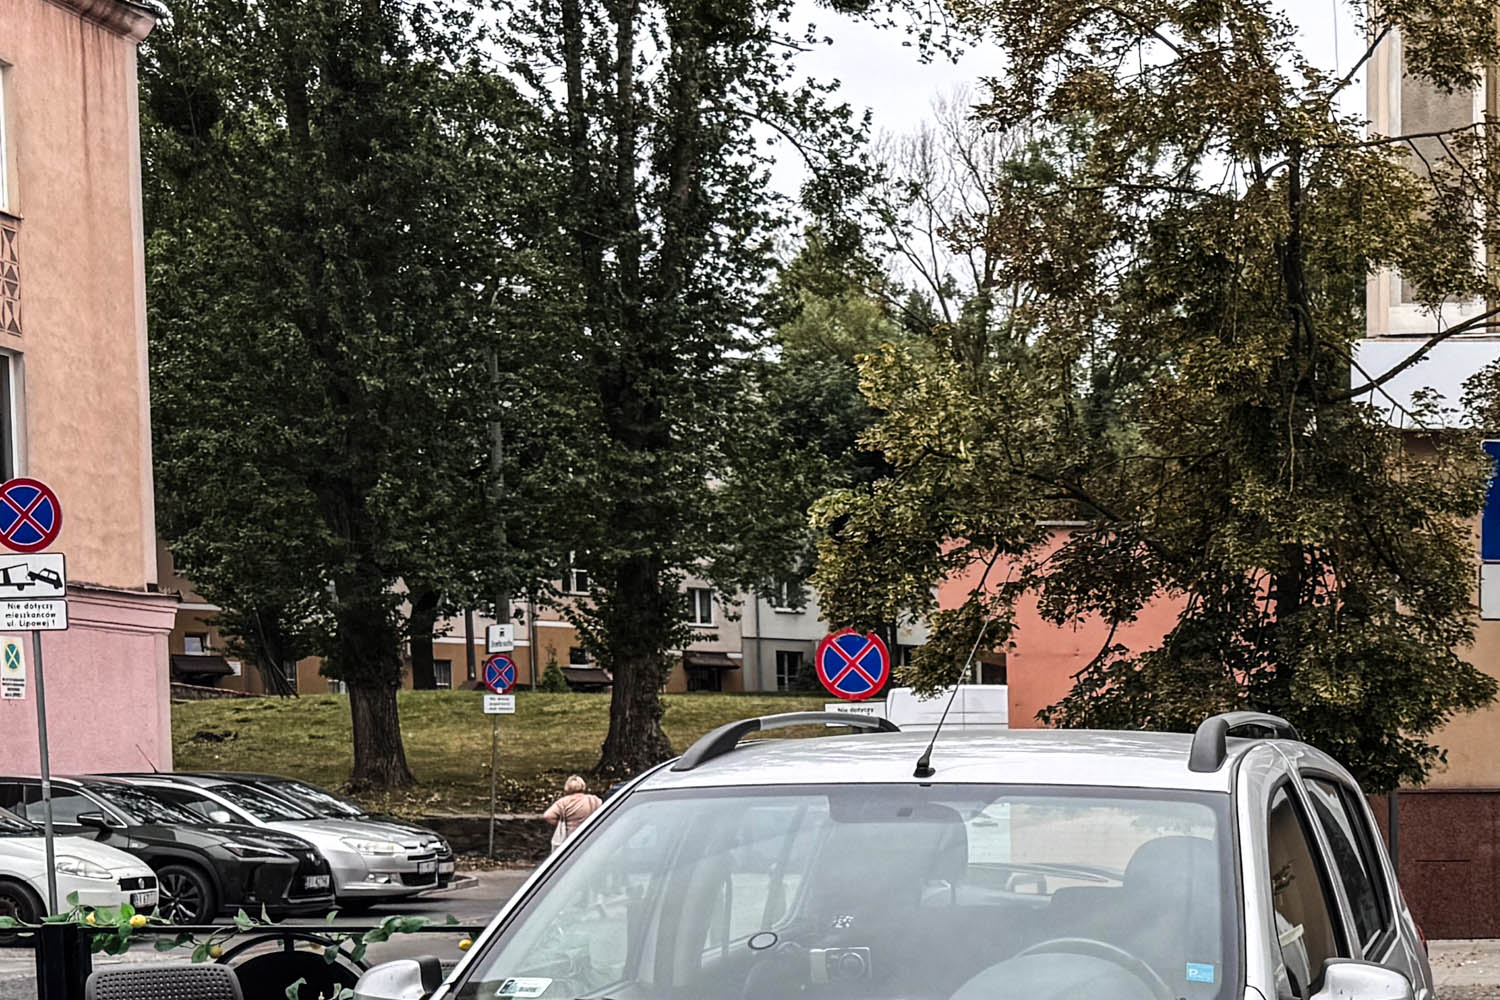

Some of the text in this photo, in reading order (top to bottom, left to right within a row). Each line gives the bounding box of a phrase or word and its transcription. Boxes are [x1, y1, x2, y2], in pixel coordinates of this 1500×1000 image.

[7, 602, 53, 610] Nie dotyczy
[19, 619, 50, 628] Lipowej
